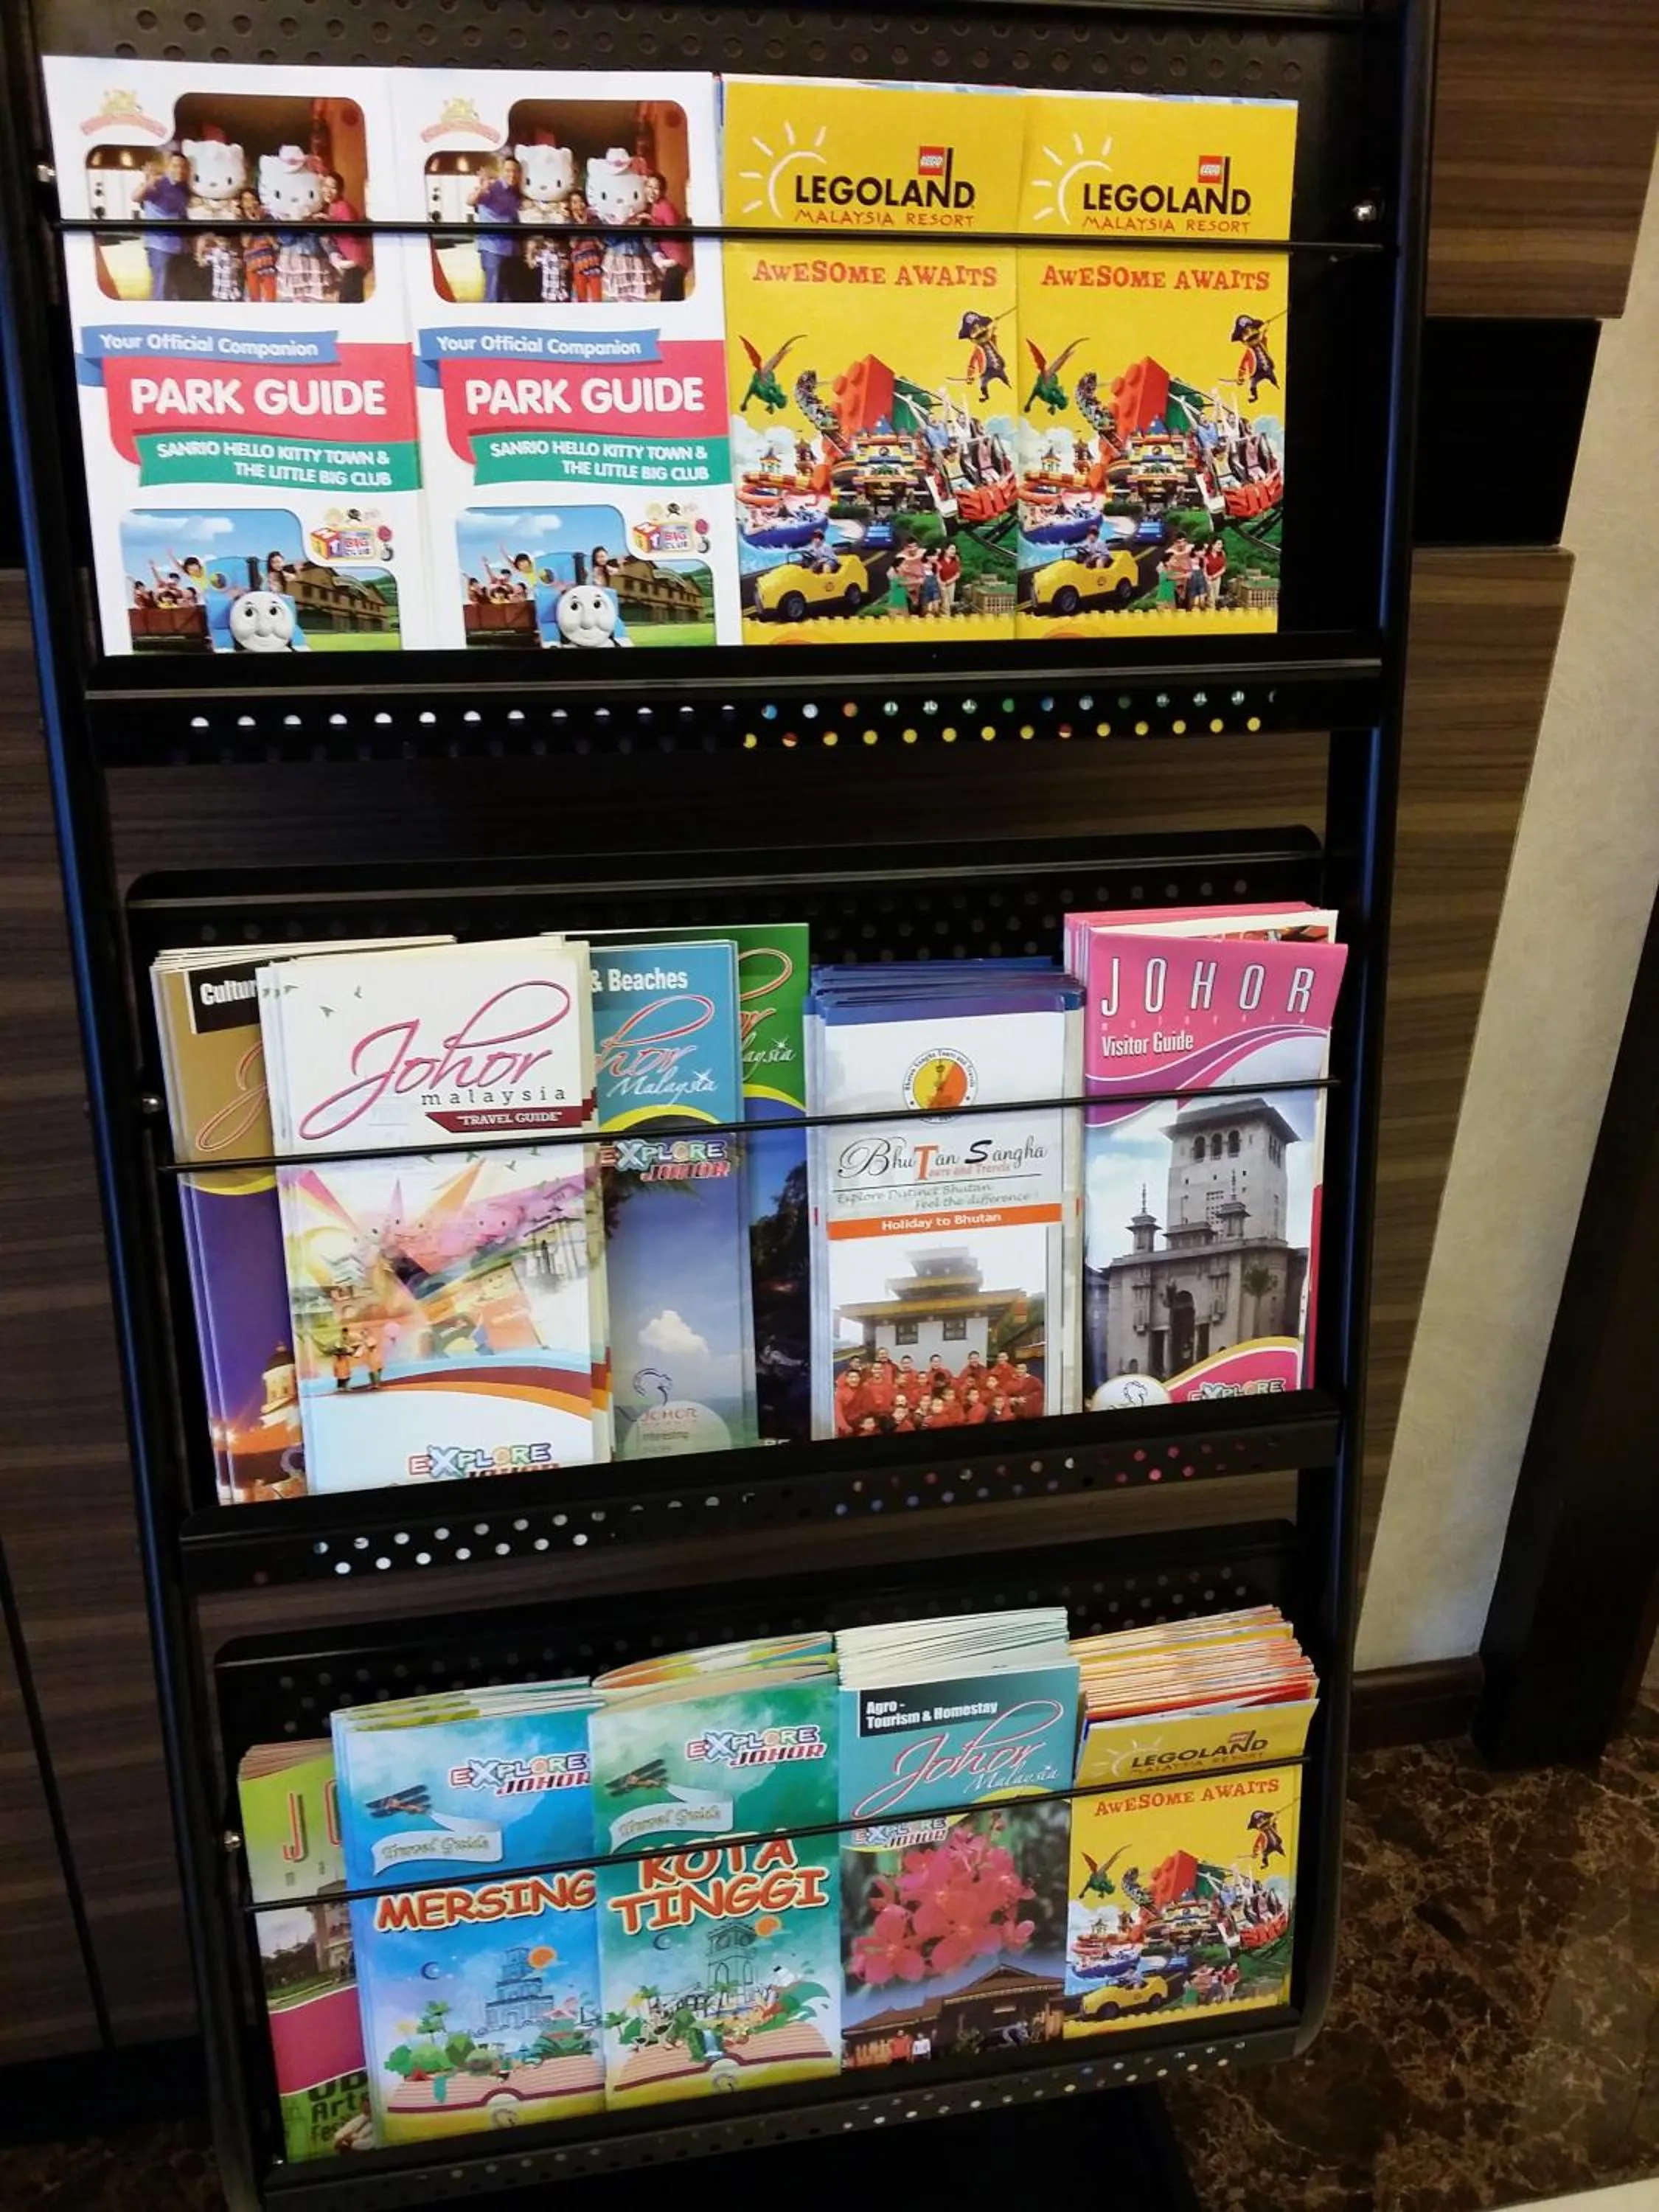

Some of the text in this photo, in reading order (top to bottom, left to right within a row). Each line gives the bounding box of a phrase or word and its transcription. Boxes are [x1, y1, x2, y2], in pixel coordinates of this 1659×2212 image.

[795, 147, 975, 209] LEGOLAND
[1083, 156, 1251, 215] LEGOLAND
[795, 209, 974, 227] MALAYSIA RESORT
[1082, 215, 1251, 234] MALAYSIA RESORT
[753, 260, 998, 287] AWESOME AWAITS
[1041, 265, 1270, 291] AWESOME AWAITS
[99, 333, 318, 358] Your Official Companion
[437, 335, 641, 358] Your Official Companion
[131, 378, 387, 416] PARK GUIDE
[465, 378, 705, 415] PARK GUIDE
[157, 442, 390, 465] SANRIO HELLO KITTY TOWN &
[490, 442, 708, 461] SANRIO HELLO KITTY TOWN &
[234, 462, 392, 487] THE LITTLE BIG CLUB
[562, 461, 709, 481] THE LITTLE BIG CLUB
[608, 967, 688, 992] Beaches
[1101, 957, 1315, 1018] JOHOR
[1102, 1030, 1194, 1058] Visitor Guide
[299, 981, 571, 1141] Johor
[421, 1087, 566, 1107] malaysia
[606, 1066, 718, 1106] Malaysia
[456, 1109, 563, 1128] TRAVEL GUIDE
[600, 1141, 726, 1170] EXPLORE
[964, 1135, 1047, 1168] Sangha
[914, 1197, 939, 1210] Feel
[942, 1194, 961, 1206] the
[942, 1183, 991, 1196] Bhutan
[881, 1213, 1001, 1231] Holiday to Bhutan
[408, 1443, 552, 1478] EXPLORE
[866, 1701, 897, 1716] Agro
[866, 1701, 998, 1729] Tourism & Homestay
[686, 1725, 819, 1761] EXPLORE
[730, 1742, 827, 1768] JOHOR
[1132, 1730, 1268, 1768] LEGOLAND
[449, 1752, 589, 1788] EXPLORE
[852, 1699, 1064, 1819] Johor
[1095, 1778, 1279, 1817] AWESOME AWAITS
[640, 1829, 797, 1891] KOTA
[375, 1870, 596, 1933] MERSING
[608, 1867, 830, 1935] TINGGI
